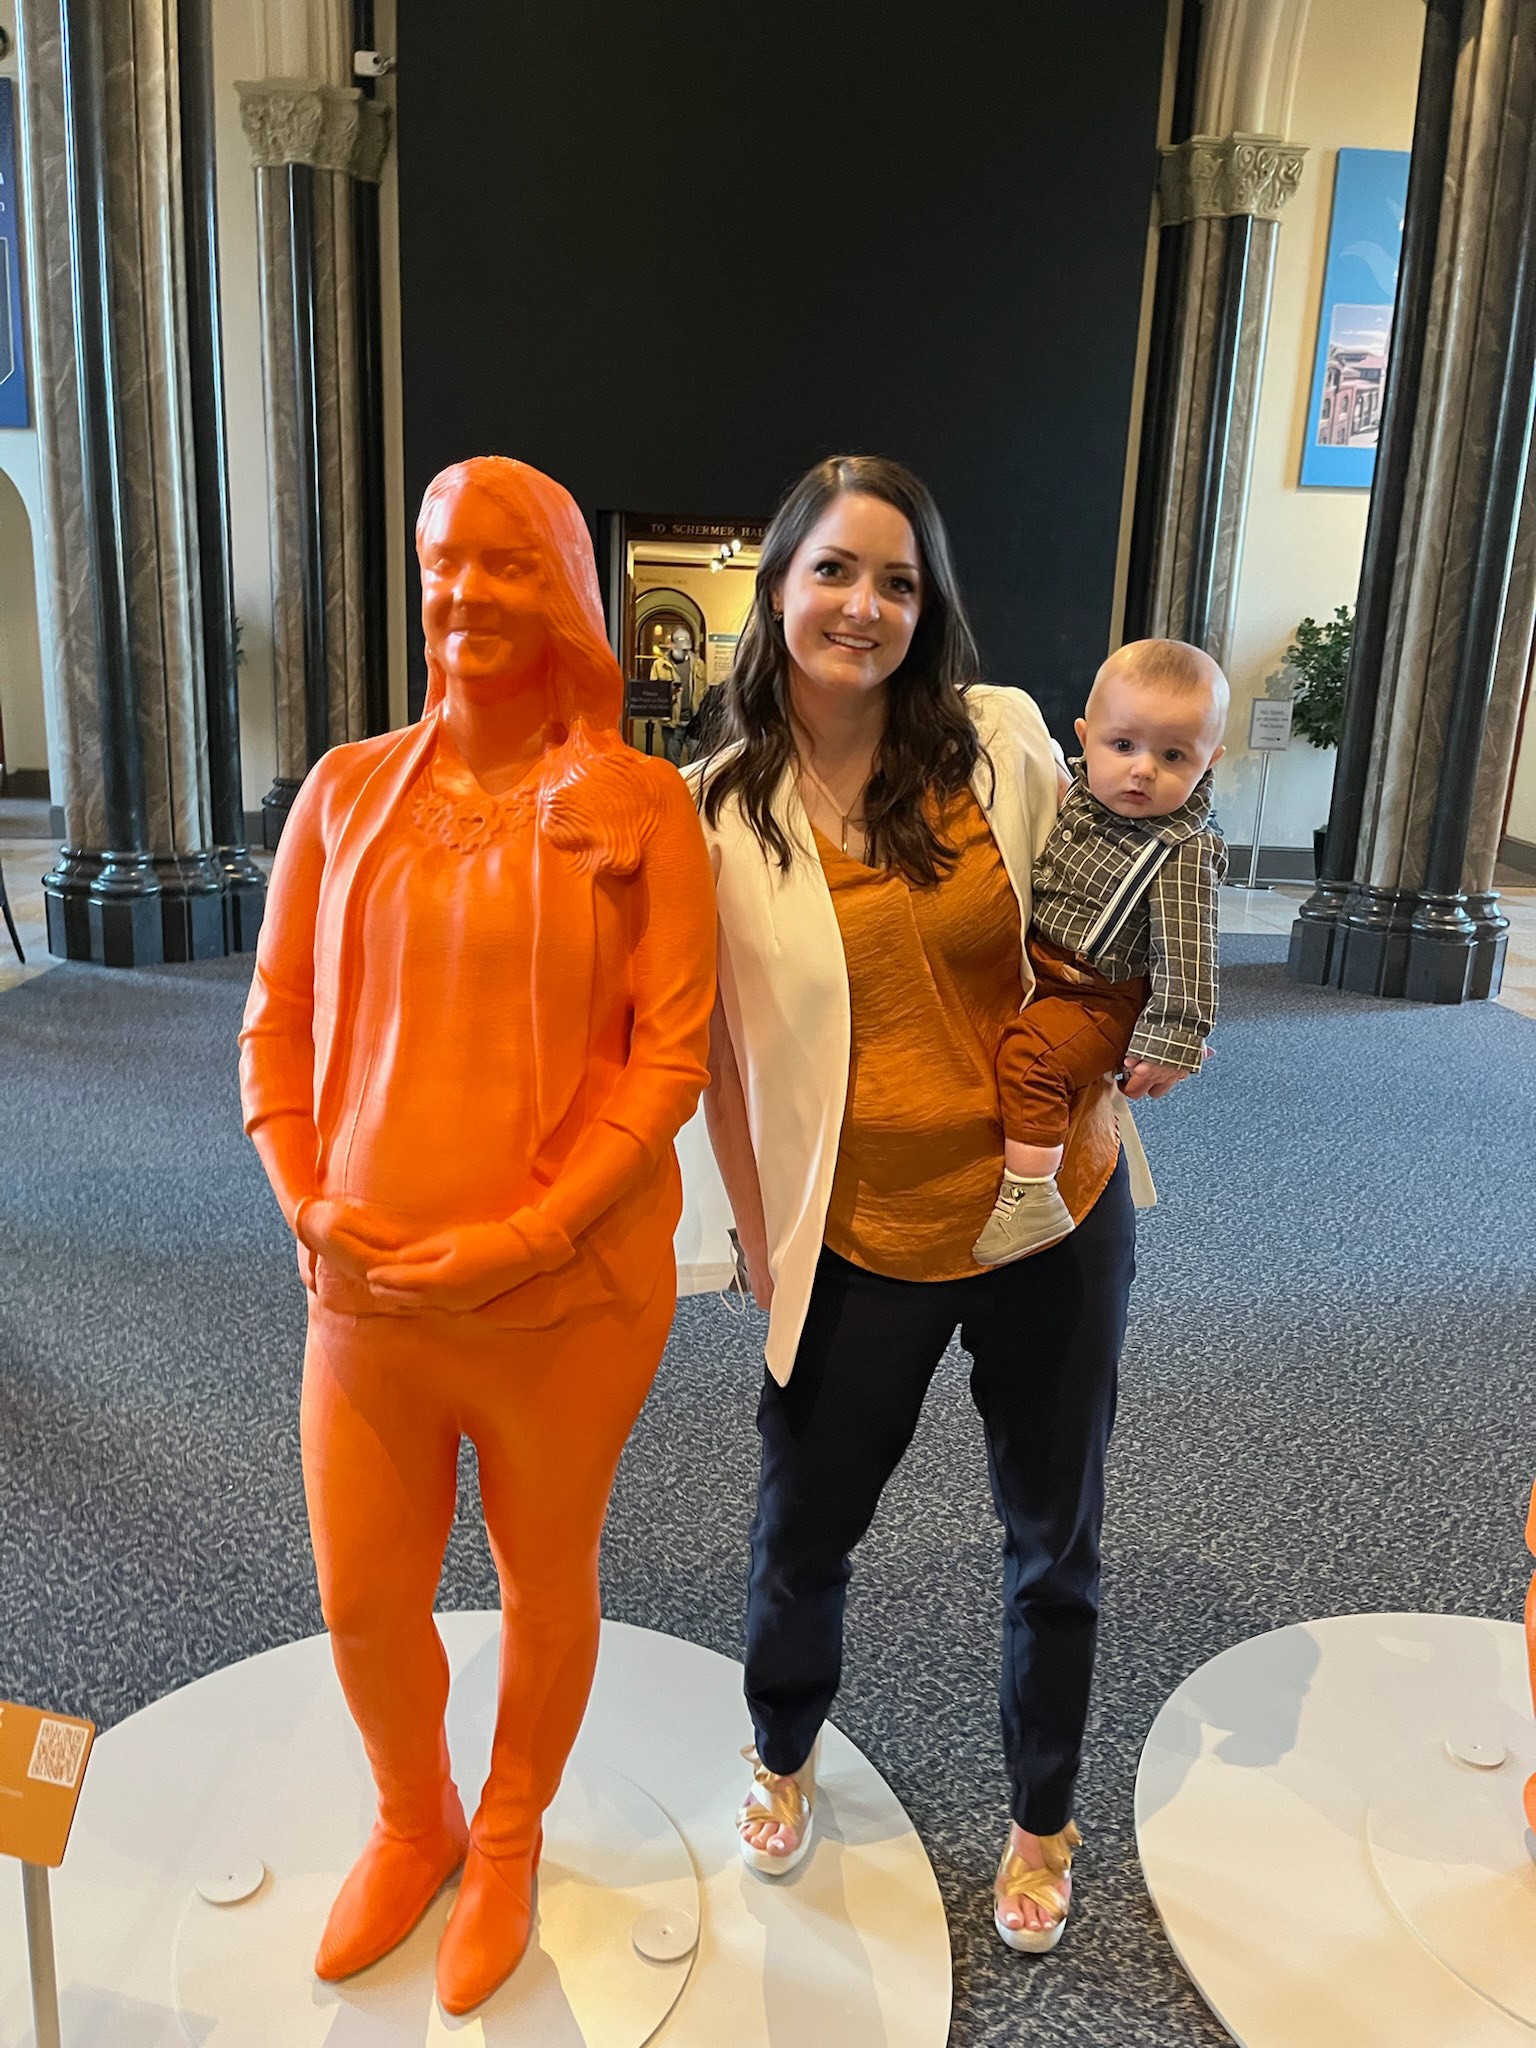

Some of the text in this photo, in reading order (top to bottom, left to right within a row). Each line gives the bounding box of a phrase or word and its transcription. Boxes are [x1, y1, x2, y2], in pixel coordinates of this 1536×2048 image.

[650, 523, 767, 538] TO SCHERMER HAL
